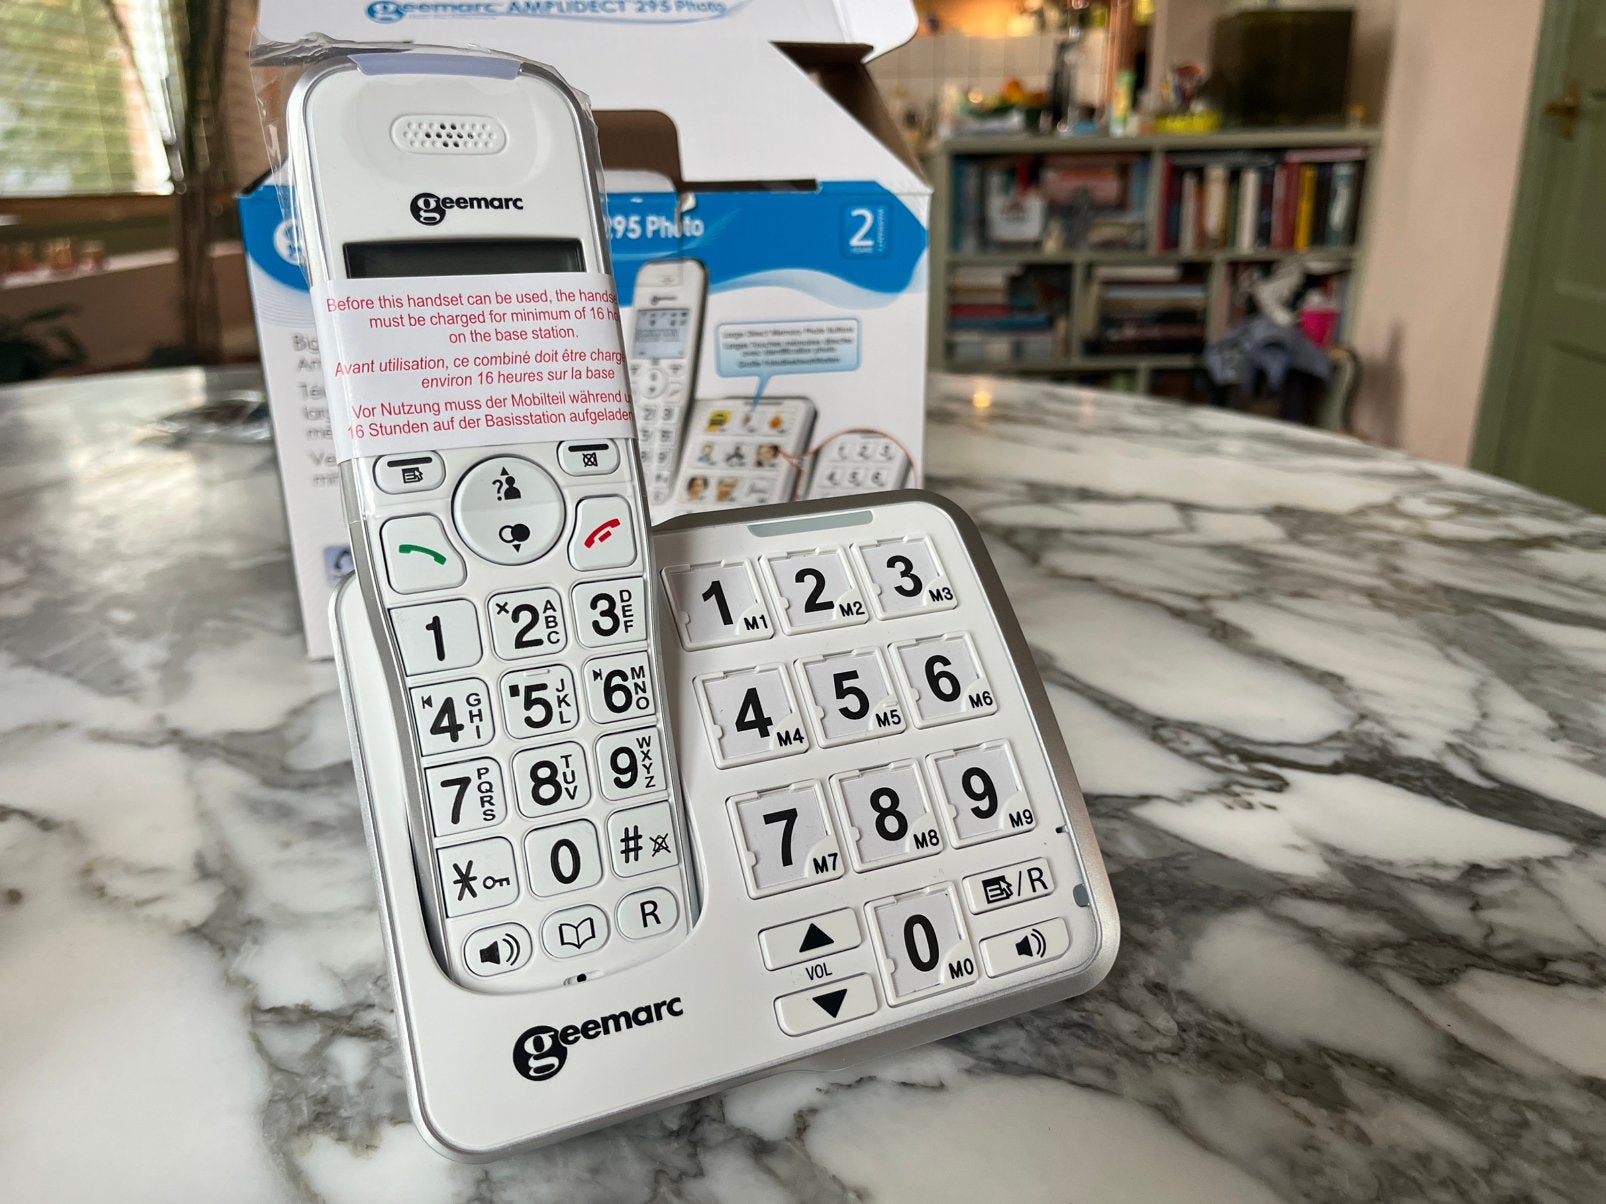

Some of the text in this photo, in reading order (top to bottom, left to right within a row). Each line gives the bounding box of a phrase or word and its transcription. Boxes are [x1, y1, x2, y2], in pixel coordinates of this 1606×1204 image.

[410, 192, 524, 226] geemarc
[609, 214, 642, 239] 95
[849, 208, 875, 247] 2
[326, 297, 375, 313] Before
[378, 295, 404, 309] this
[407, 293, 464, 307] handset
[467, 294, 492, 306] can
[495, 291, 513, 305] be
[516, 290, 552, 306] used,
[554, 289, 577, 303] the
[369, 314, 405, 328] must
[407, 313, 427, 327] be
[430, 311, 487, 328] charged
[489, 310, 508, 323] for
[511, 308, 571, 323] minimum
[574, 307, 587, 320] of
[590, 307, 605, 320] 16
[449, 325, 579, 344] on the base station.
[335, 360, 375, 377] Avant
[379, 356, 449, 373] utilisation,
[453, 356, 470, 369] ce
[473, 352, 531, 368] combiné
[535, 350, 559, 364] doit
[561, 347, 587, 363] être
[421, 366, 616, 389] environ 16 heures sur la base
[347, 425, 365, 440] 16
[368, 420, 430, 438] Stunden
[433, 416, 455, 432] auf
[459, 415, 482, 430] der
[485, 410, 567, 429] Basisstation
[352, 403, 376, 420] Vor
[380, 402, 441, 418] Nutzung
[445, 398, 483, 412] muss
[485, 395, 508, 409] der
[510, 391, 567, 408] Mobilteil
[569, 389, 623, 405] während
[794, 567, 865, 617] 2 M2
[886, 554, 954, 603] 3 M3
[511, 603, 544, 649] 2
[589, 592, 620, 637] 3
[701, 580, 769, 631] 1 M1
[426, 616, 446, 661] 1
[603, 669, 633, 714] 6
[832, 669, 902, 728] 5 M5
[924, 654, 994, 709] 6 M6
[430, 697, 465, 742] 4
[523, 682, 554, 729] 5
[734, 687, 805, 747] 4 M4
[529, 760, 563, 806] 8
[609, 746, 639, 789] 9
[440, 776, 472, 825] 7
[869, 786, 940, 850] 8 M8
[961, 766, 1034, 829] 9 M9
[550, 838, 581, 884] 0
[620, 825, 643, 863] #
[762, 807, 839, 875] 7 M7
[639, 900, 662, 928] R
[903, 913, 975, 980] 0 M0
[805, 962, 833, 981] VOL
[513, 996, 684, 1081] geemarc
